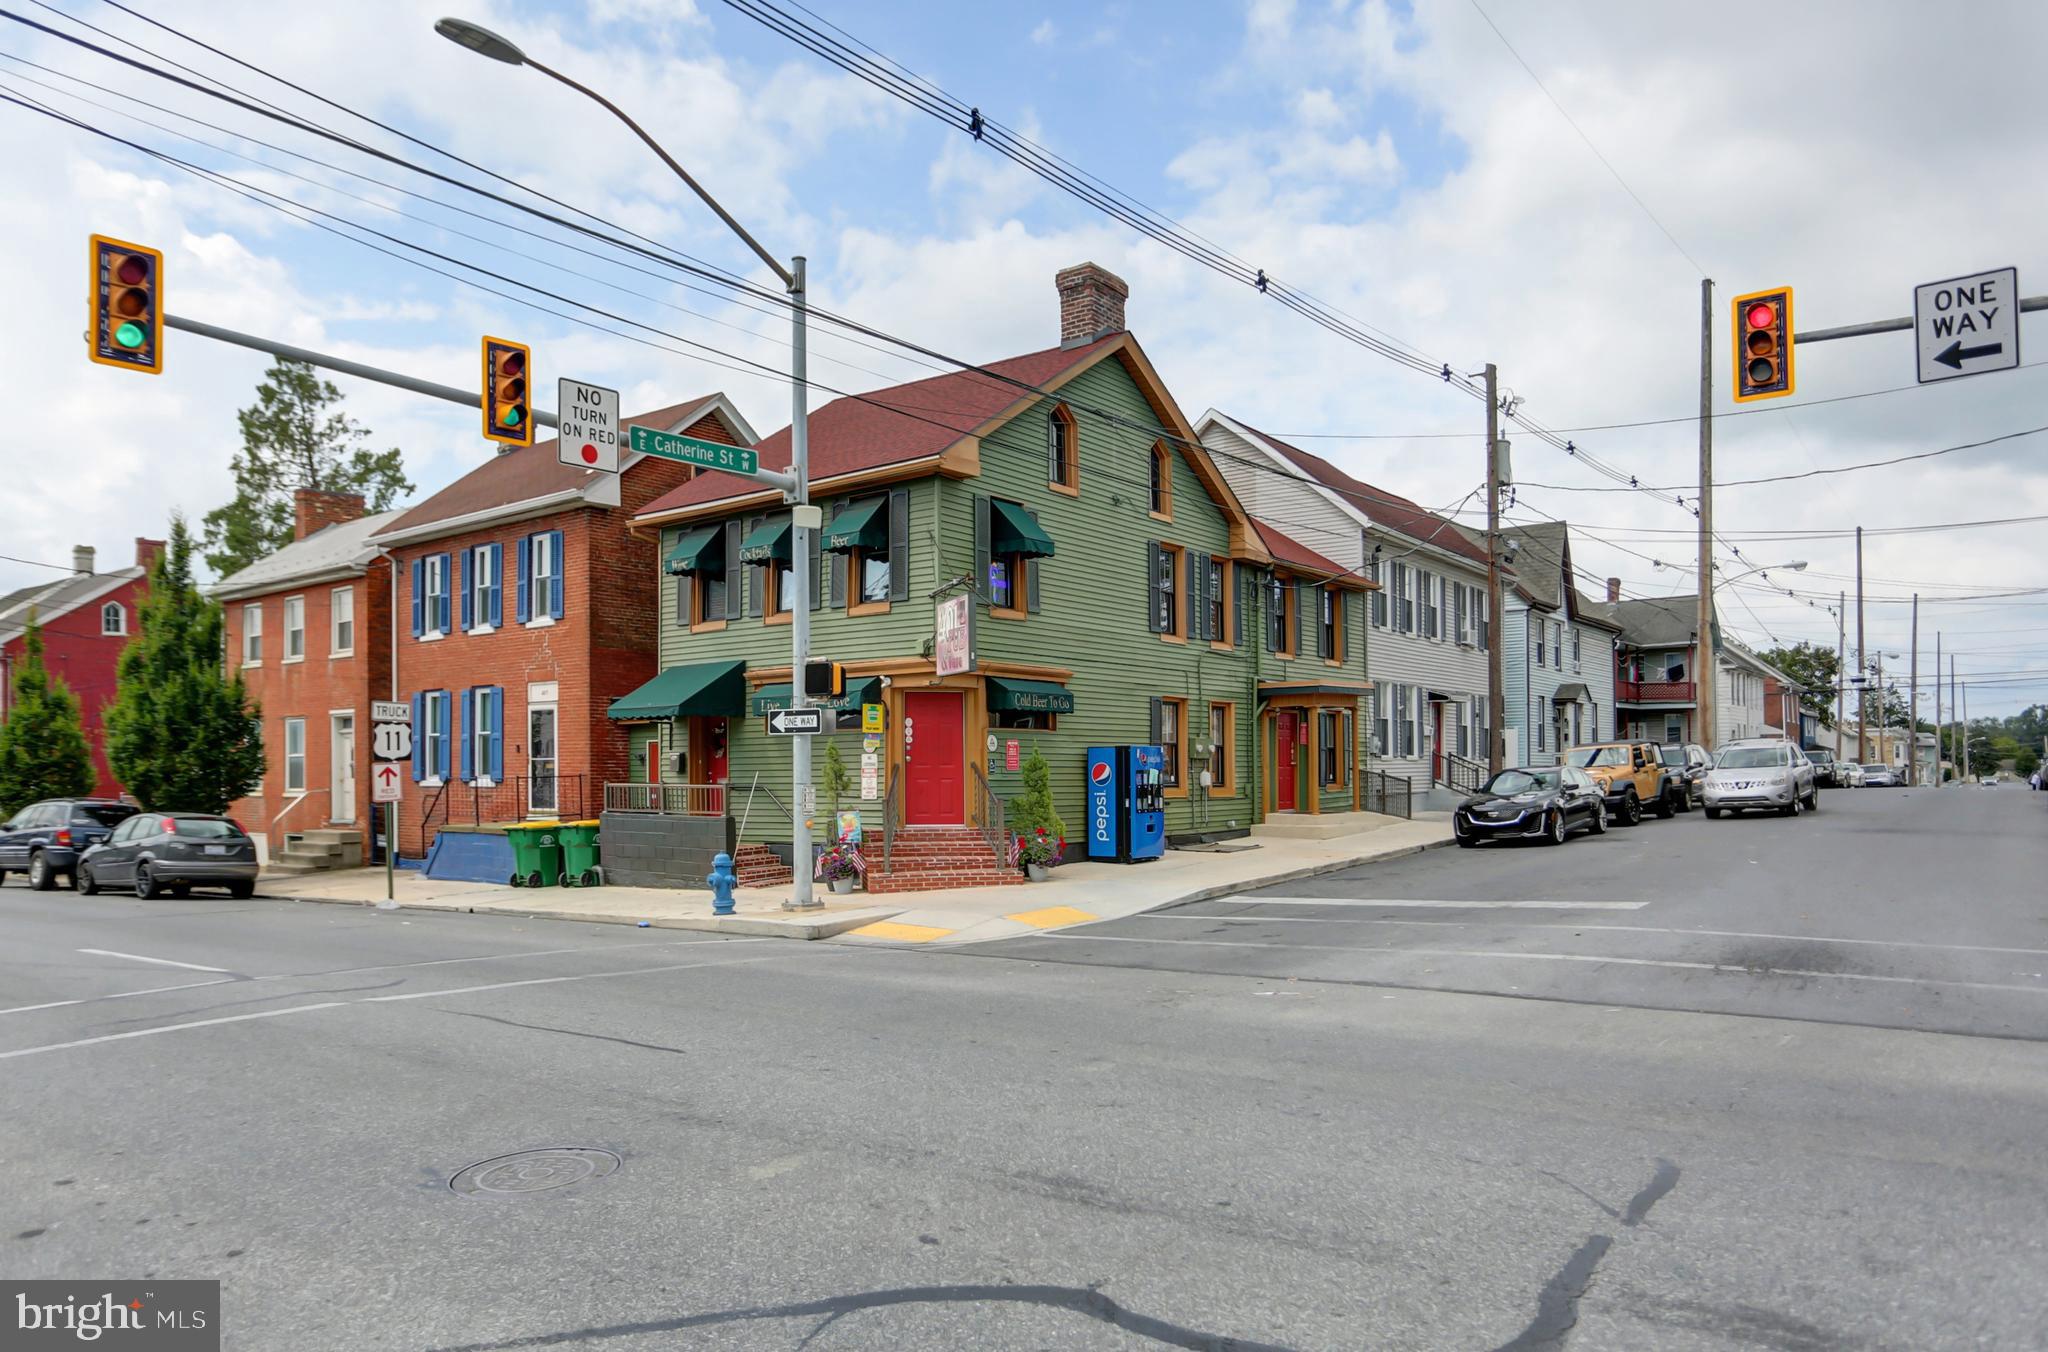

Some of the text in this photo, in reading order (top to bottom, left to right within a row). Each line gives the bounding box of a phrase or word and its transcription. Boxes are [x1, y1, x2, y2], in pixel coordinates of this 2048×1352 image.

[1934, 280, 1996, 312] ONE
[1933, 307, 1999, 339] WAY
[577, 386, 602, 406] NO
[572, 405, 607, 426] TURN
[563, 422, 615, 445] ON RED
[639, 436, 750, 471] E Catherine St W
[830, 535, 849, 547] Beer
[739, 546, 772, 561] Cocktails
[761, 699, 780, 712] Live
[827, 697, 850, 709] Love
[1014, 692, 1070, 709] Cold Beer To Go
[375, 704, 408, 718] TRUCK
[783, 716, 816, 727] ONE WAY
[385, 731, 401, 751] 11
[1094, 791, 1110, 841] pepsi
